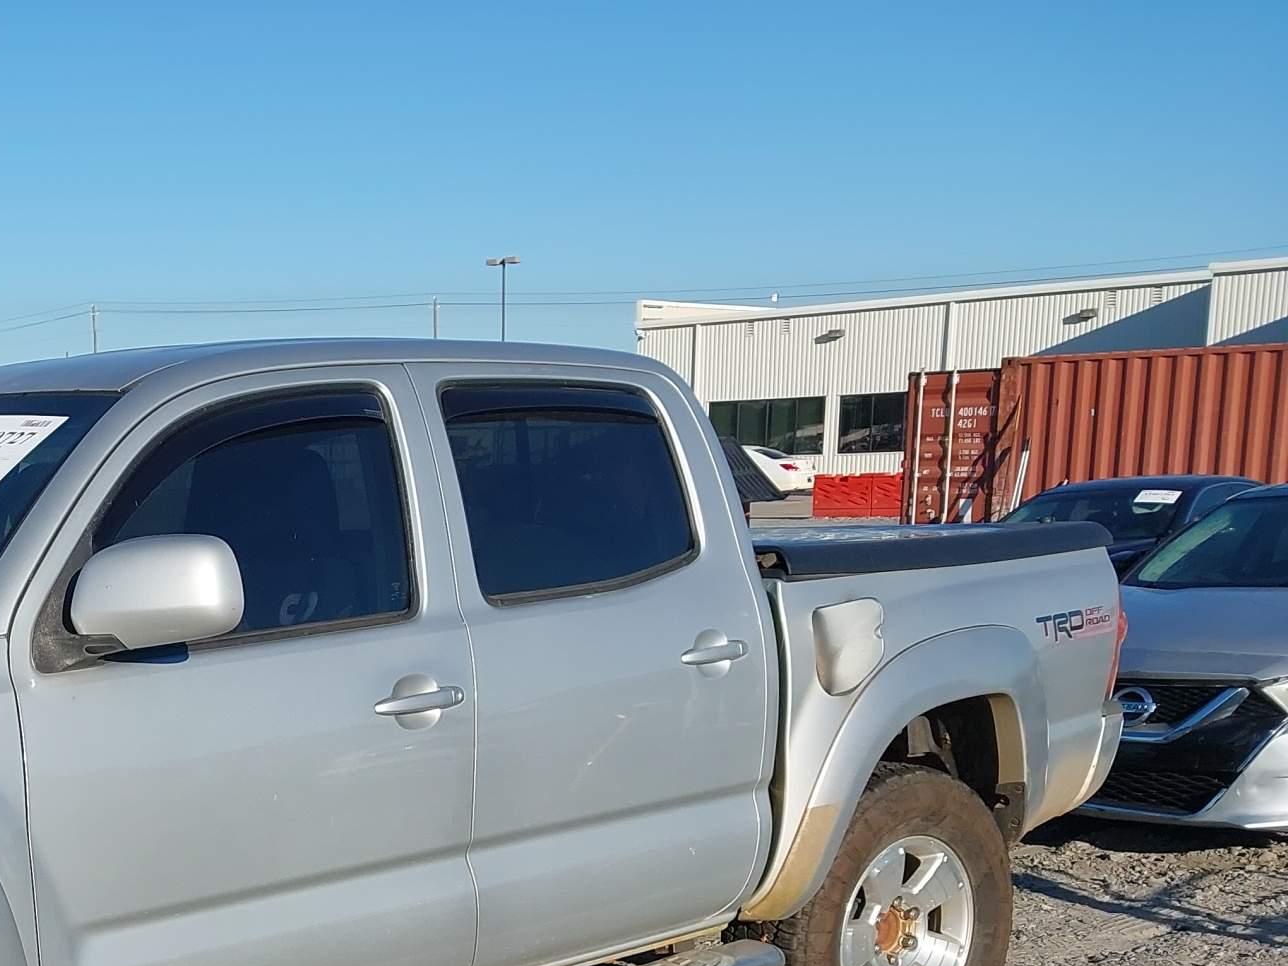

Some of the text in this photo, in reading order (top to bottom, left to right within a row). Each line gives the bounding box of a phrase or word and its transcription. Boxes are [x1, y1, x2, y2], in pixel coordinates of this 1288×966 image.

[958, 407, 987, 417] 400146
[1036, 610, 1084, 641] TRD
[1086, 615, 1110, 626] ROAD
